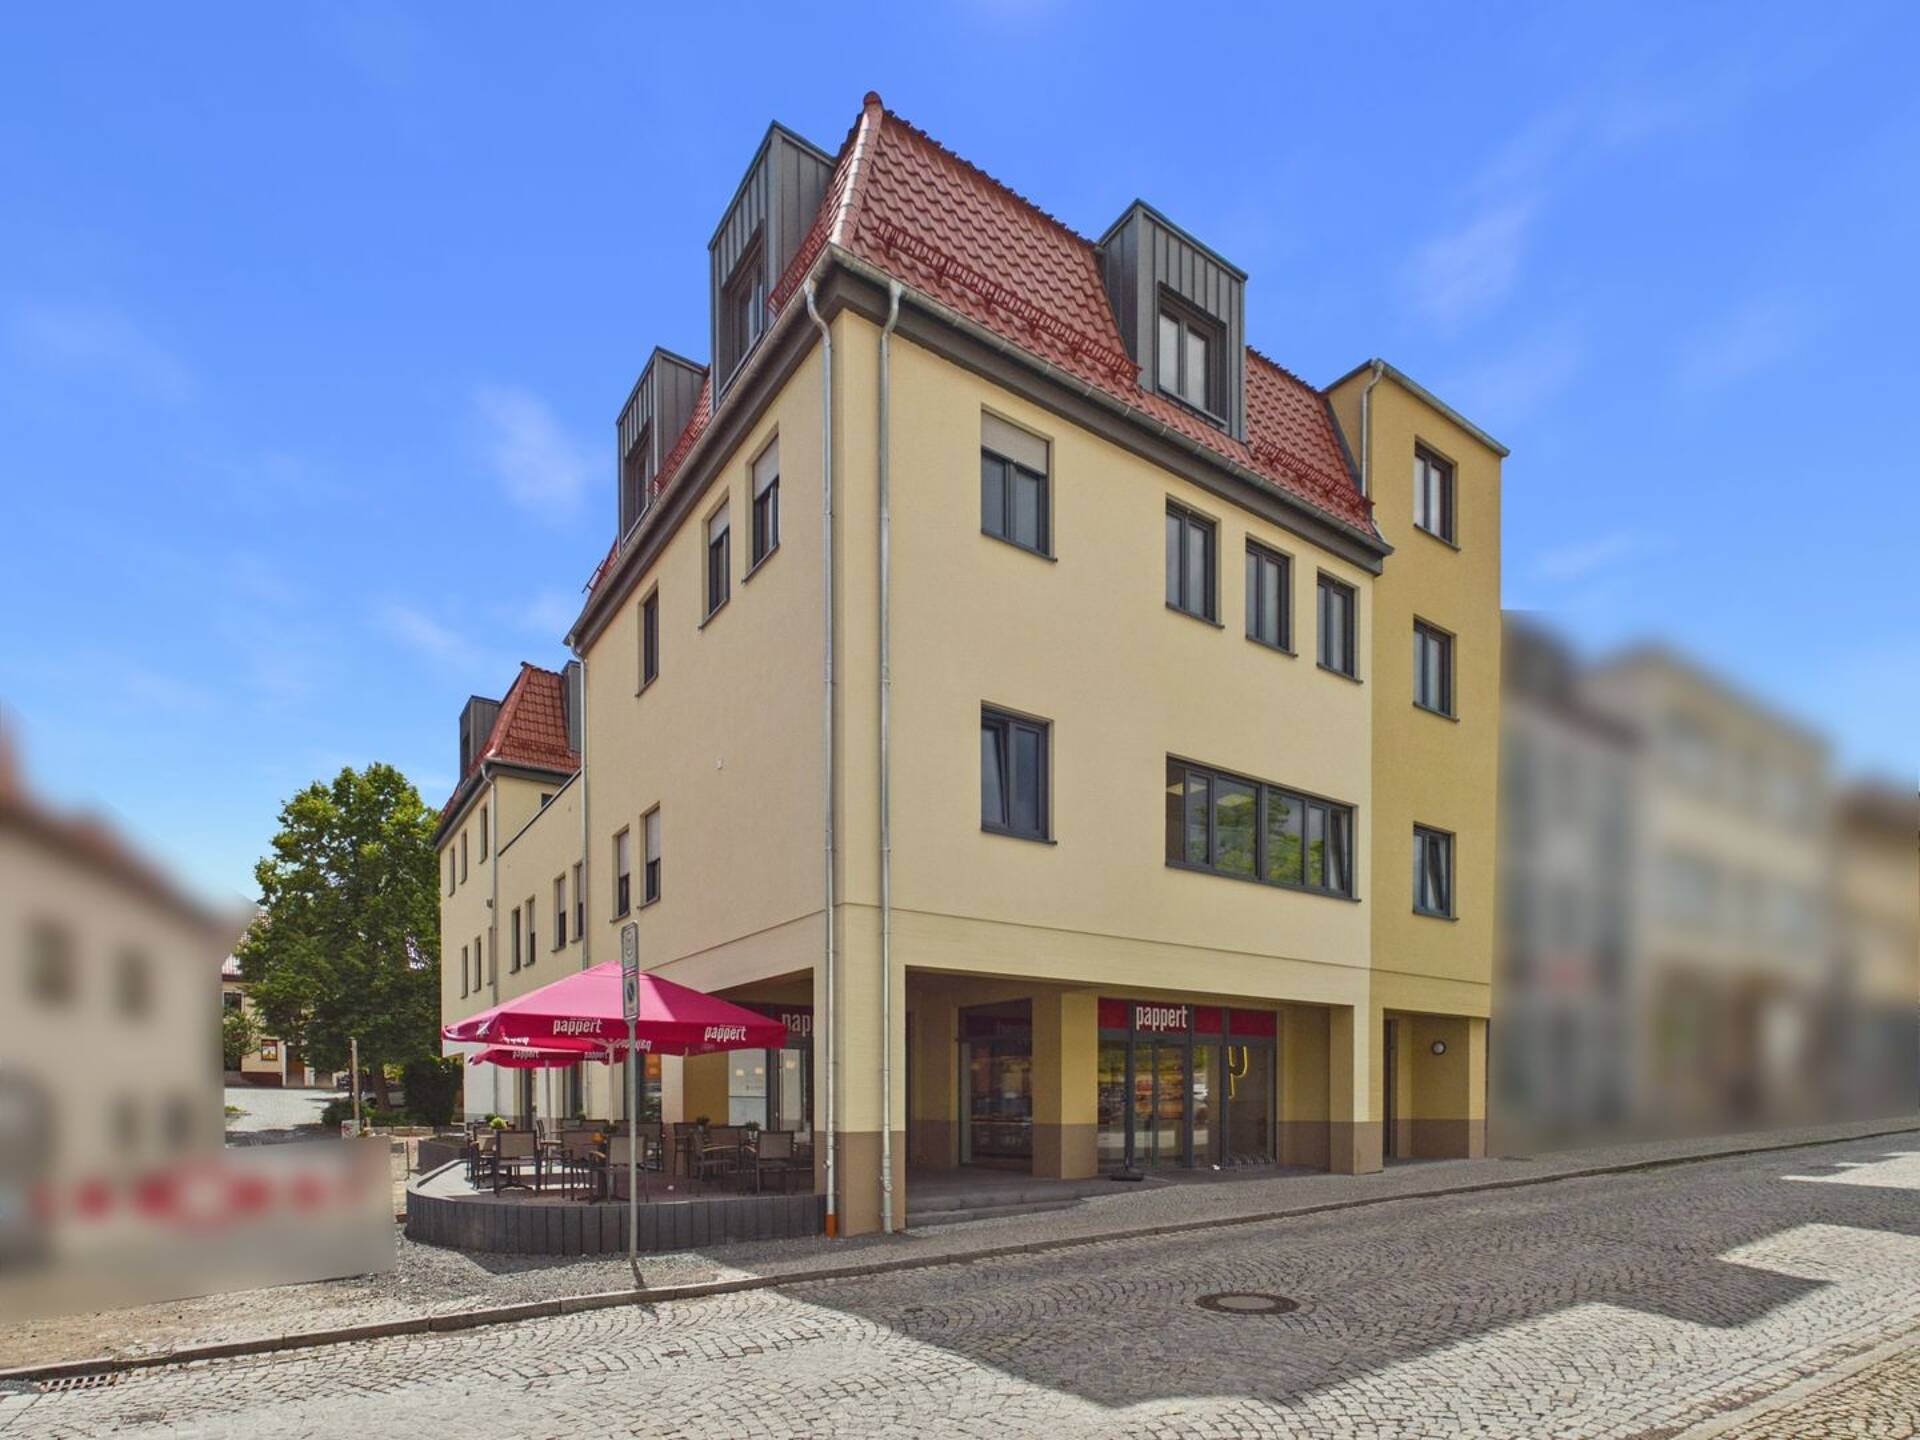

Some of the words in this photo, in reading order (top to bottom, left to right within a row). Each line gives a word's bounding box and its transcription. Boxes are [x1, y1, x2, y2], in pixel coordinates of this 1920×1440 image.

[552, 1018, 603, 1036] pappert
[781, 1013, 814, 1037] pap
[1135, 1005, 1187, 1032] pappert
[703, 1025, 747, 1043] pappert
